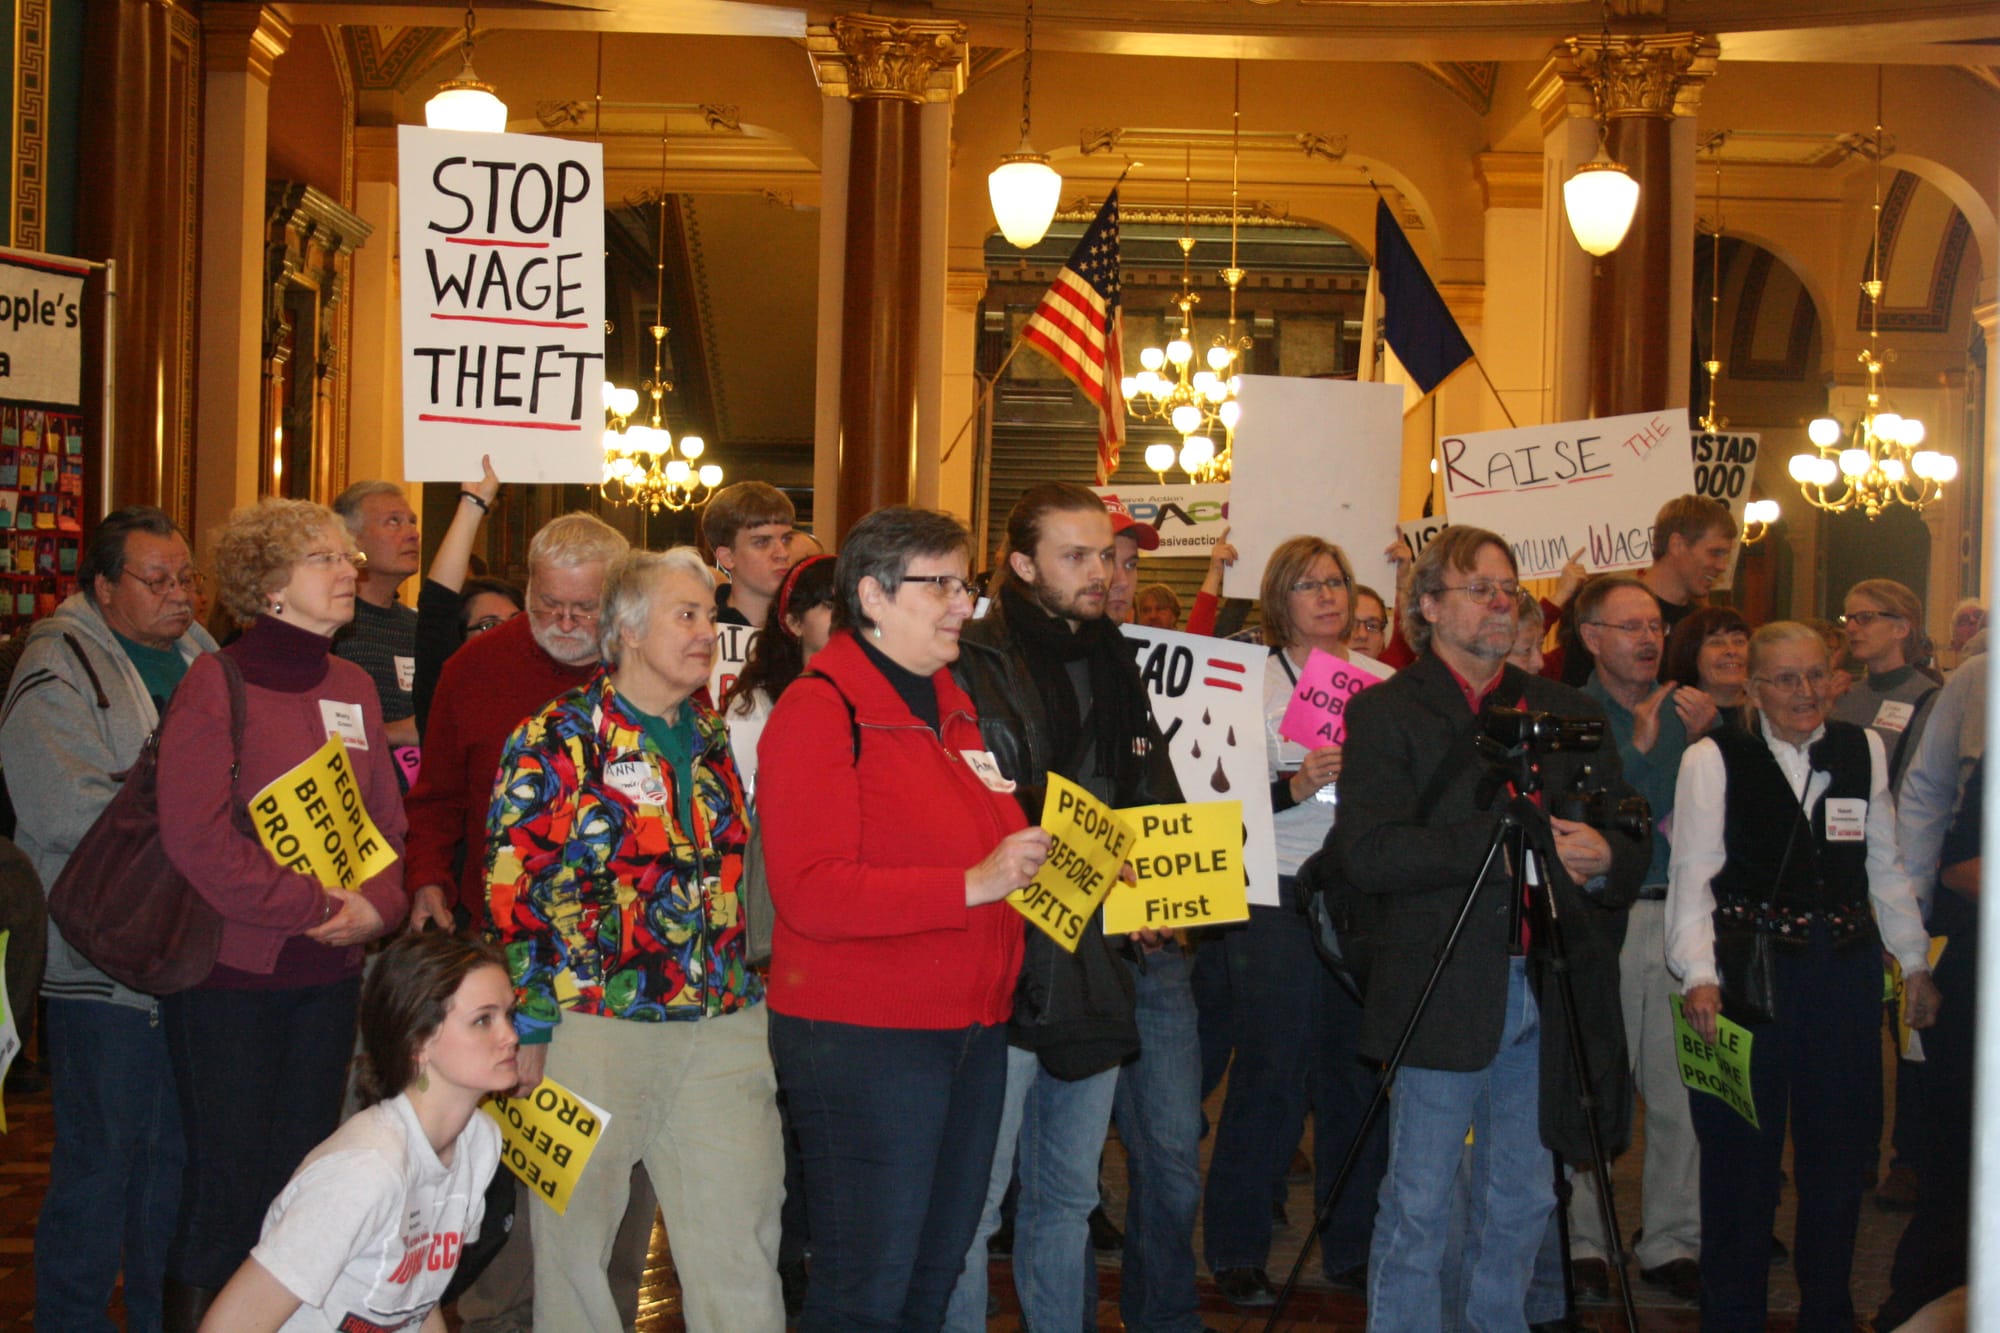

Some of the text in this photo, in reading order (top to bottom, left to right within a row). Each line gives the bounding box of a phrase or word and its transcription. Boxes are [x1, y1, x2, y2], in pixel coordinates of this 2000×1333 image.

[428, 156, 591, 238] STOP
[425, 248, 585, 320] WAGE
[413, 344, 604, 421] THEFT
[1442, 416, 1671, 493] RAISE THE
[1503, 533, 1570, 573] MUM
[1300, 686, 1345, 715] JOB
[294, 778, 355, 889] BEFORE
[327, 752, 379, 862] PEOPLE
[1058, 789, 1125, 858] PEOPLE
[1142, 813, 1193, 838] Put
[1047, 833, 1103, 896] BEFORE
[1145, 895, 1211, 922] First
